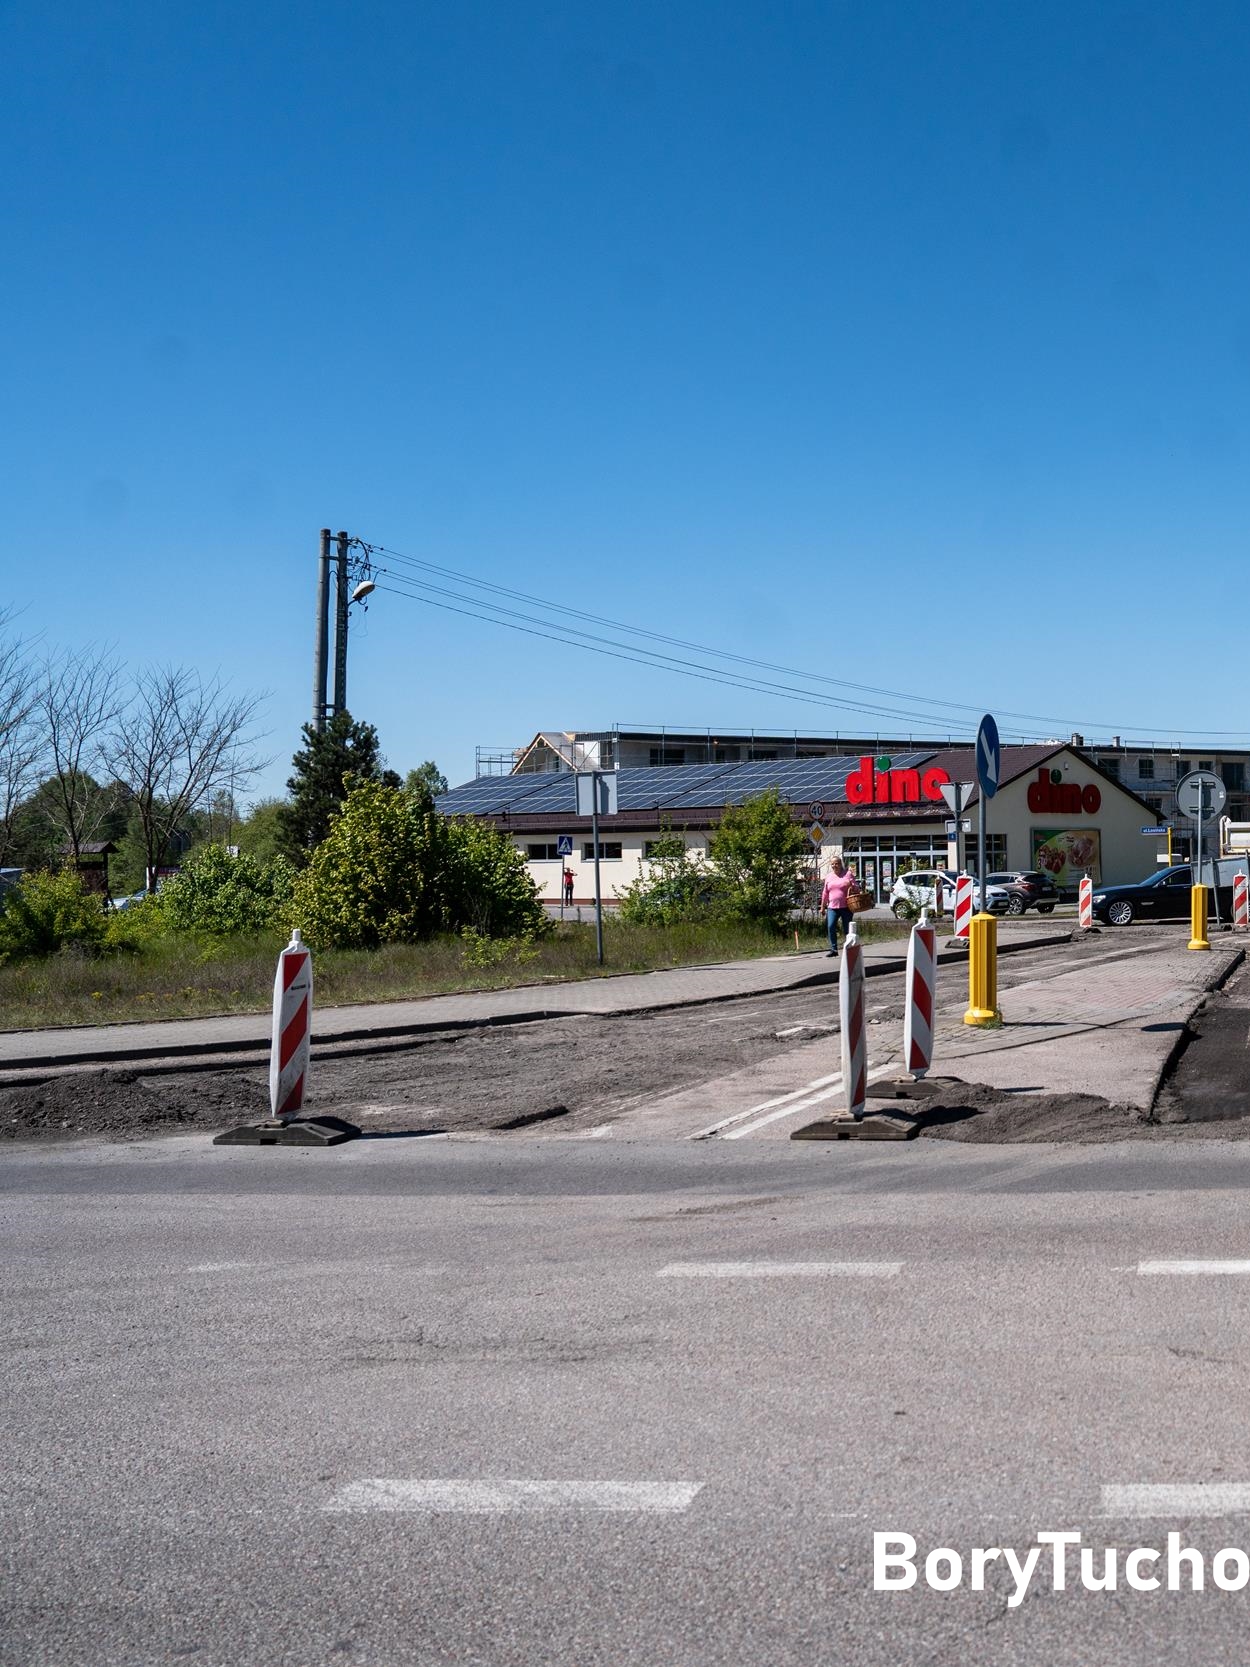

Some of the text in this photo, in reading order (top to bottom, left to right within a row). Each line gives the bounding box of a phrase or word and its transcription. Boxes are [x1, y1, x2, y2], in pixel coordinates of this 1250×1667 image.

[845, 756, 951, 806] dino
[1027, 768, 1102, 814] dino
[811, 805, 822, 816] 40
